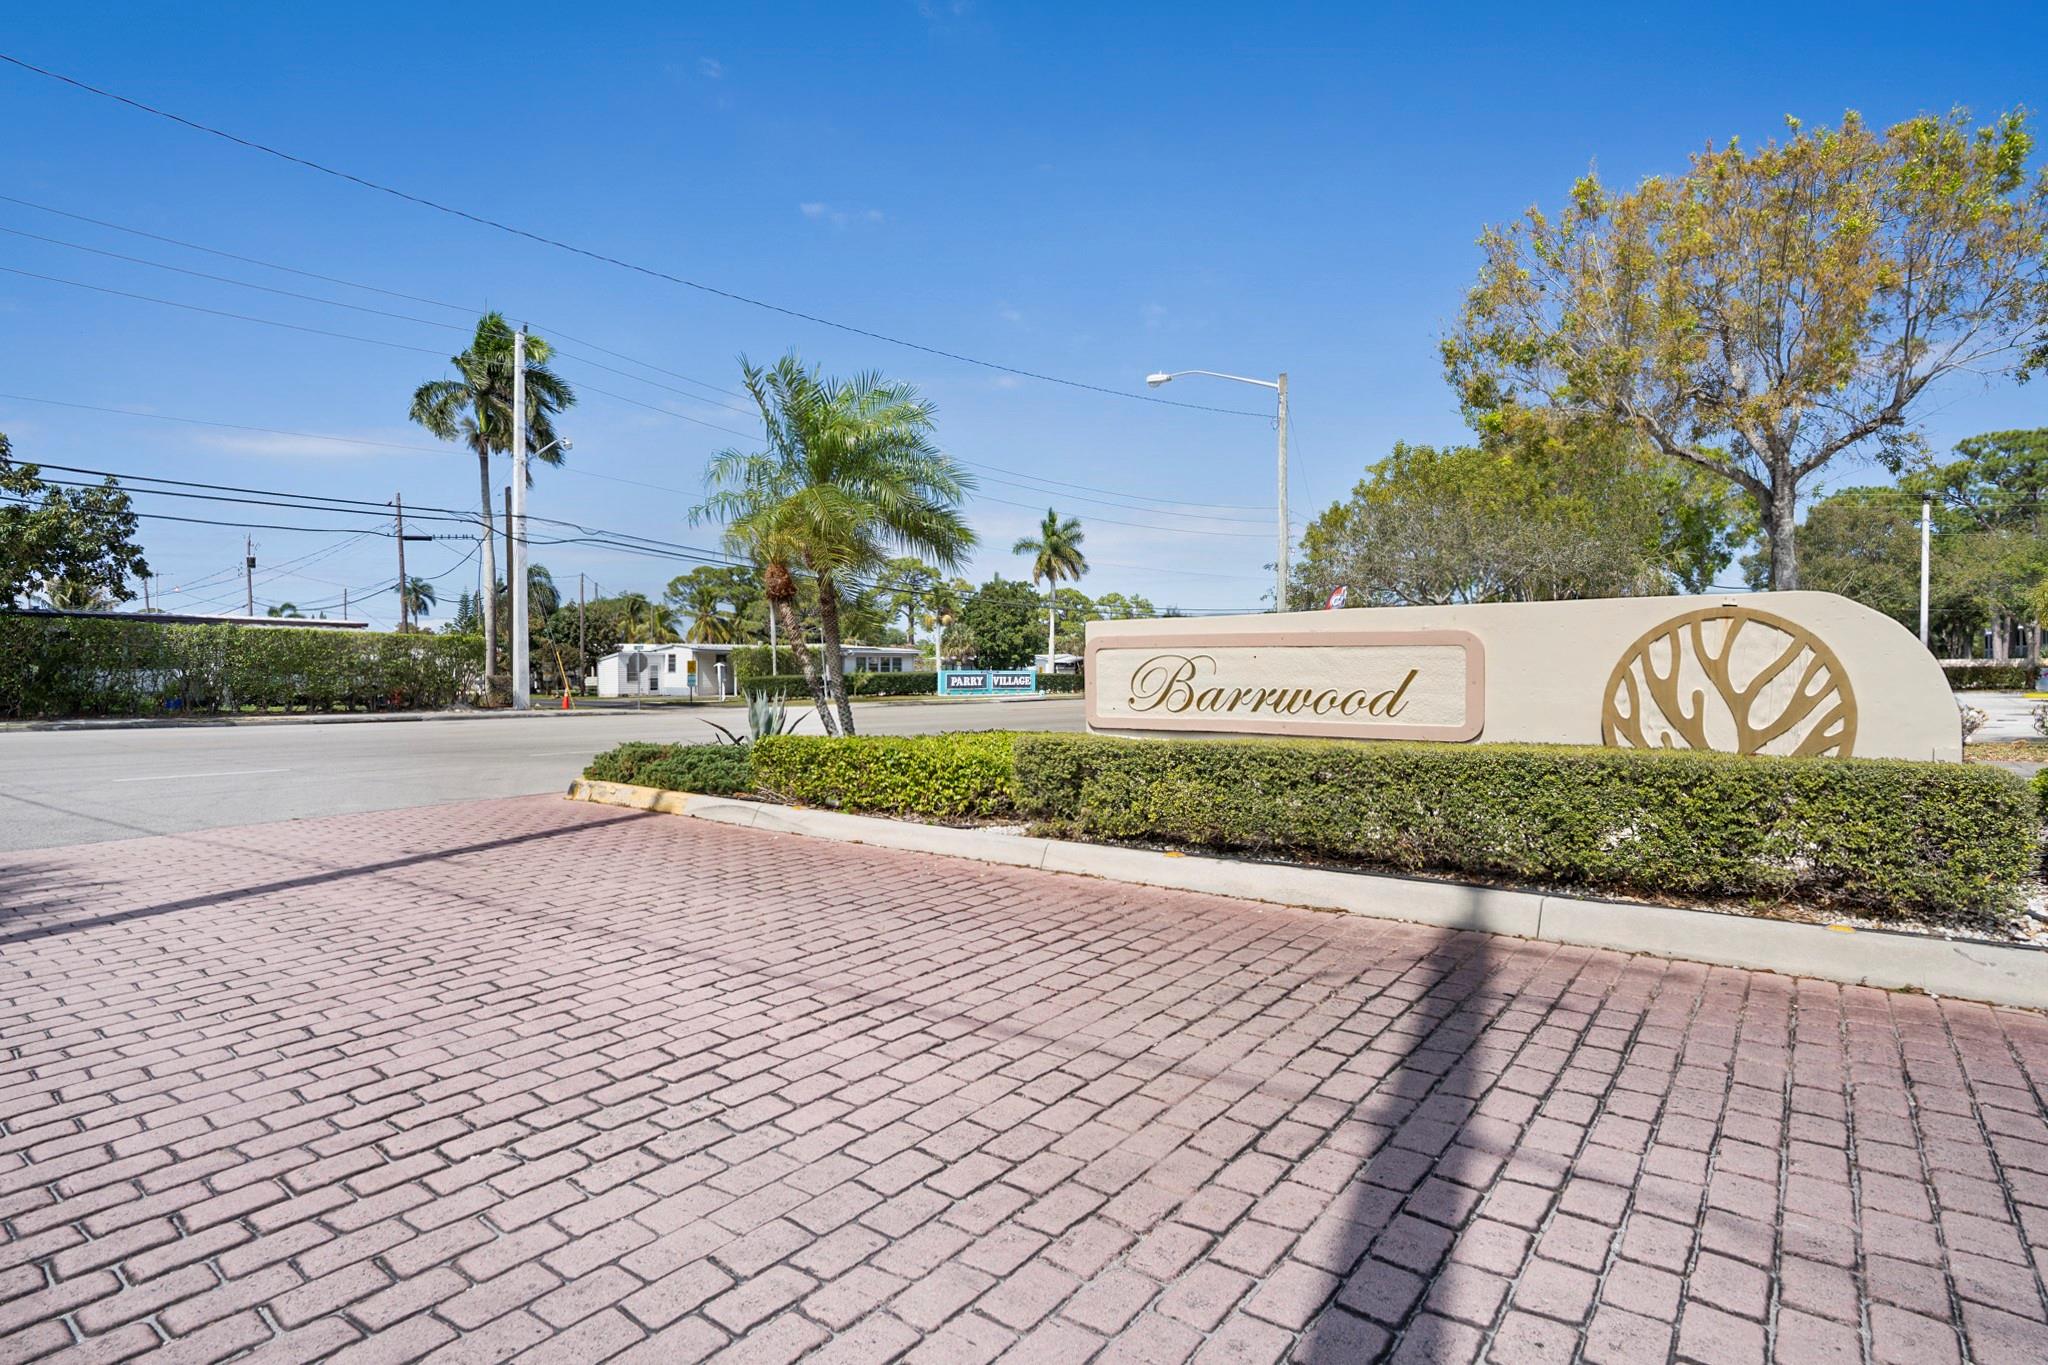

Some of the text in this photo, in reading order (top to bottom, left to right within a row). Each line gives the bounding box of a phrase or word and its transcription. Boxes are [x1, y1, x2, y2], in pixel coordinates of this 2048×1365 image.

[951, 676, 1031, 686] PARRY VILLAGE
[1128, 654, 1418, 717] Barrwood
